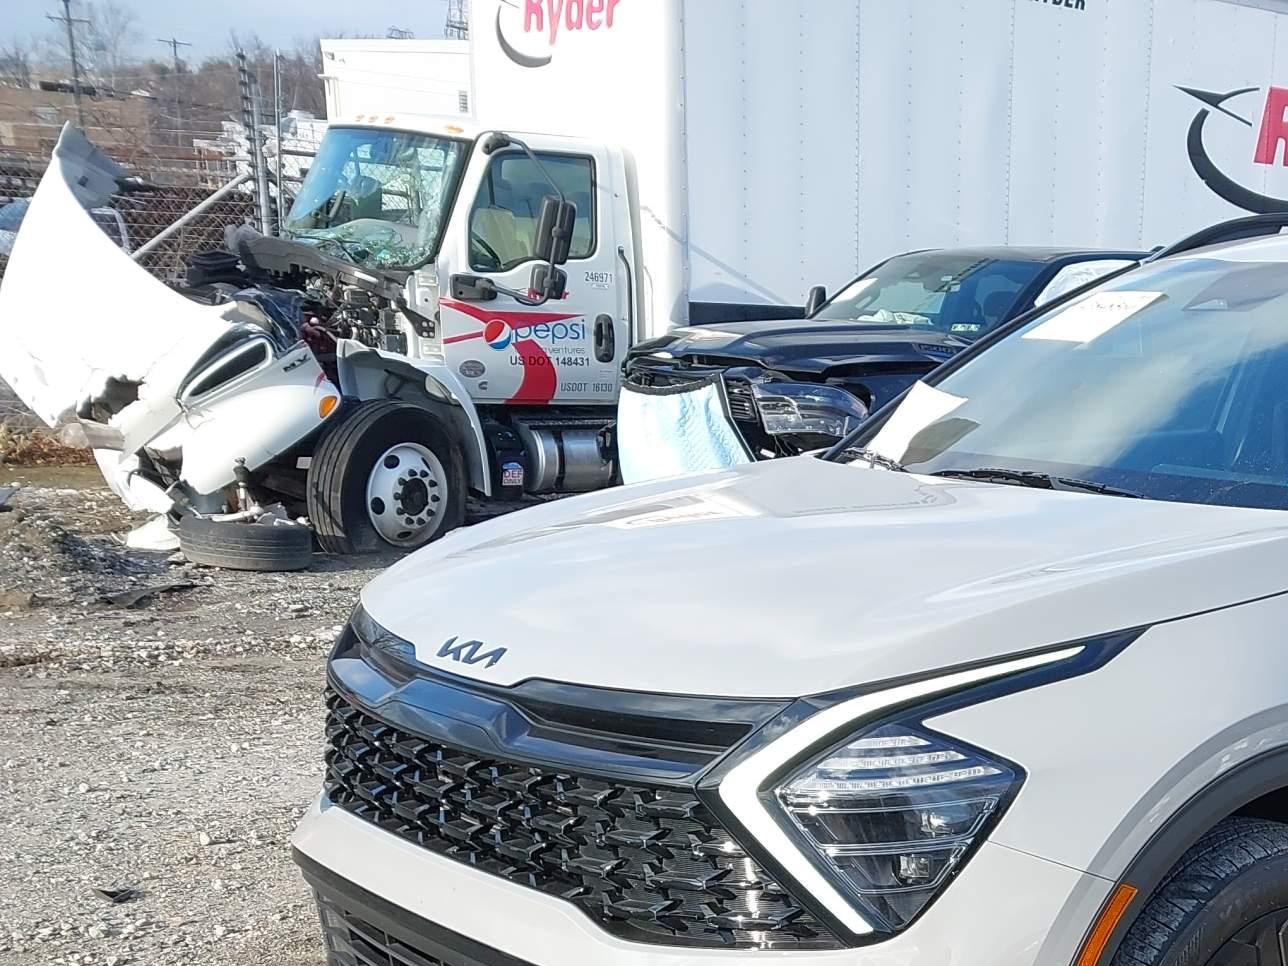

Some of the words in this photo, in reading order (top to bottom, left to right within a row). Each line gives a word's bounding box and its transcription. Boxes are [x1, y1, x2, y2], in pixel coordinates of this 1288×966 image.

[584, 271, 613, 284] 246971
[513, 319, 586, 345] pepsi
[510, 356, 526, 366] US
[528, 356, 552, 366] DOT
[555, 357, 590, 367] 148431
[560, 382, 588, 392] USDOT
[436, 635, 508, 669] KIA
